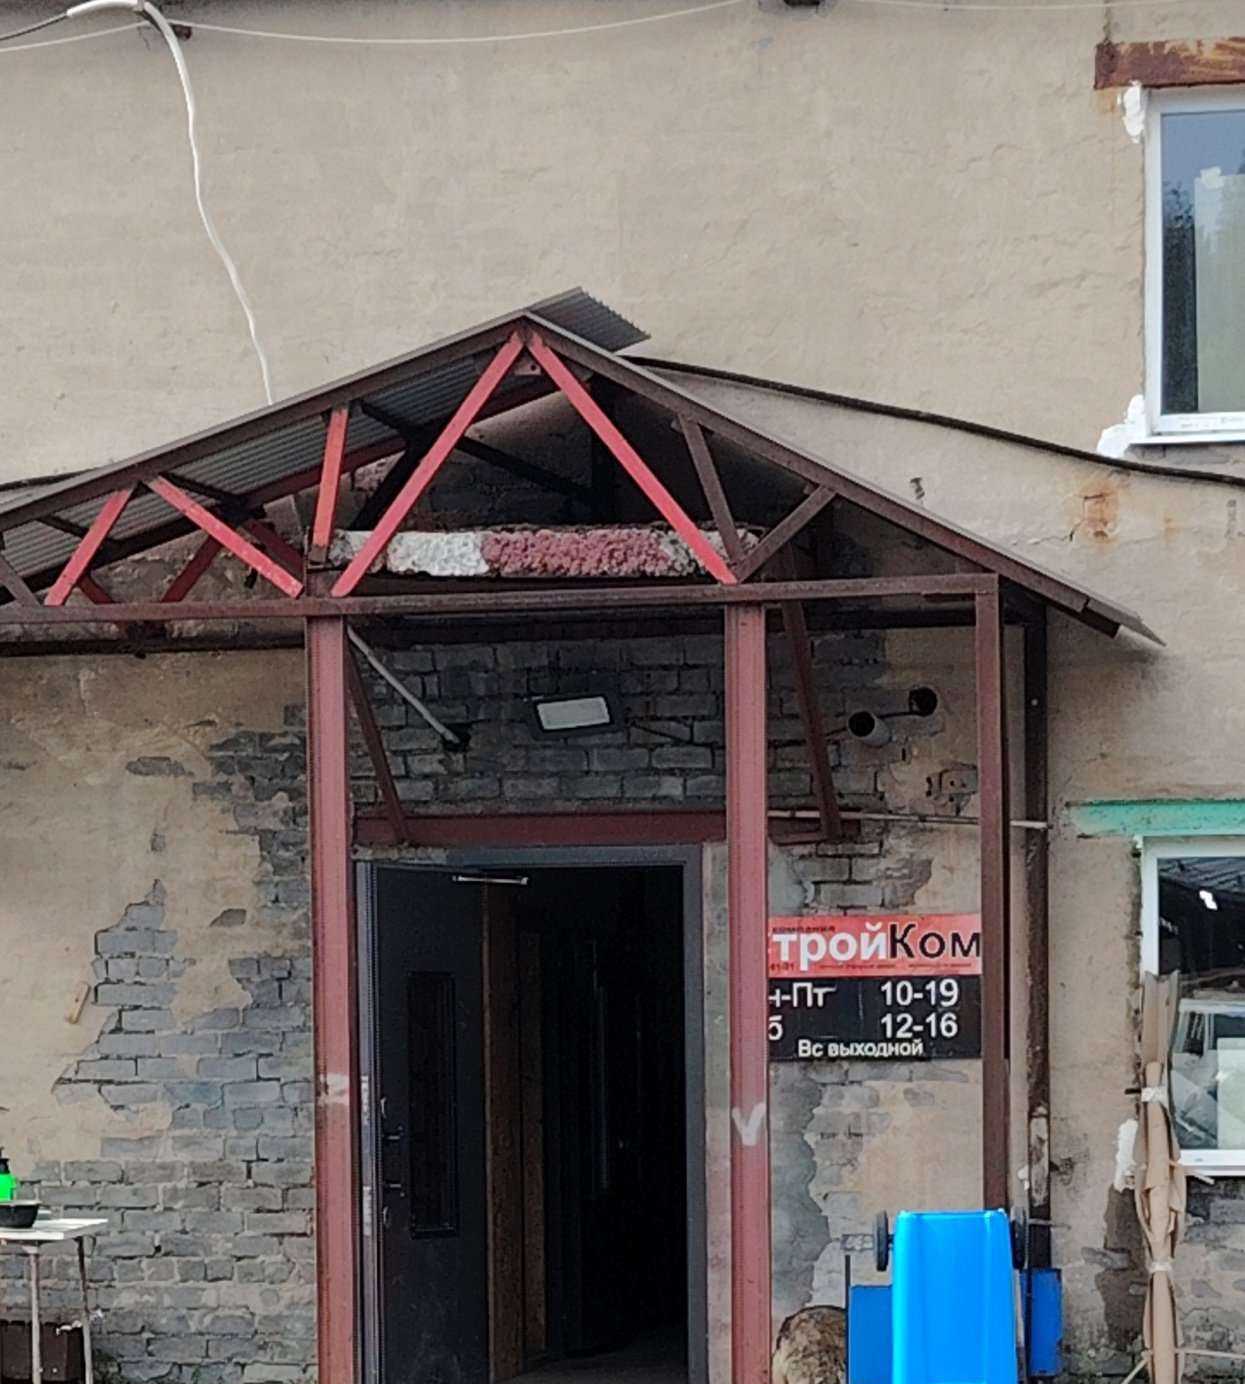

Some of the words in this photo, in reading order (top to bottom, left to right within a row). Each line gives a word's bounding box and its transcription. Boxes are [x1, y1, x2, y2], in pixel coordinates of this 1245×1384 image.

[768, 922, 981, 972] тройКом
[768, 981, 837, 1008] н-Пт
[880, 979, 959, 1007] 10-19
[768, 1014, 784, 1041] б
[880, 1013, 959, 1039] 12-16
[797, 1039, 824, 1058] Вс
[828, 1039, 923, 1058] выходной
